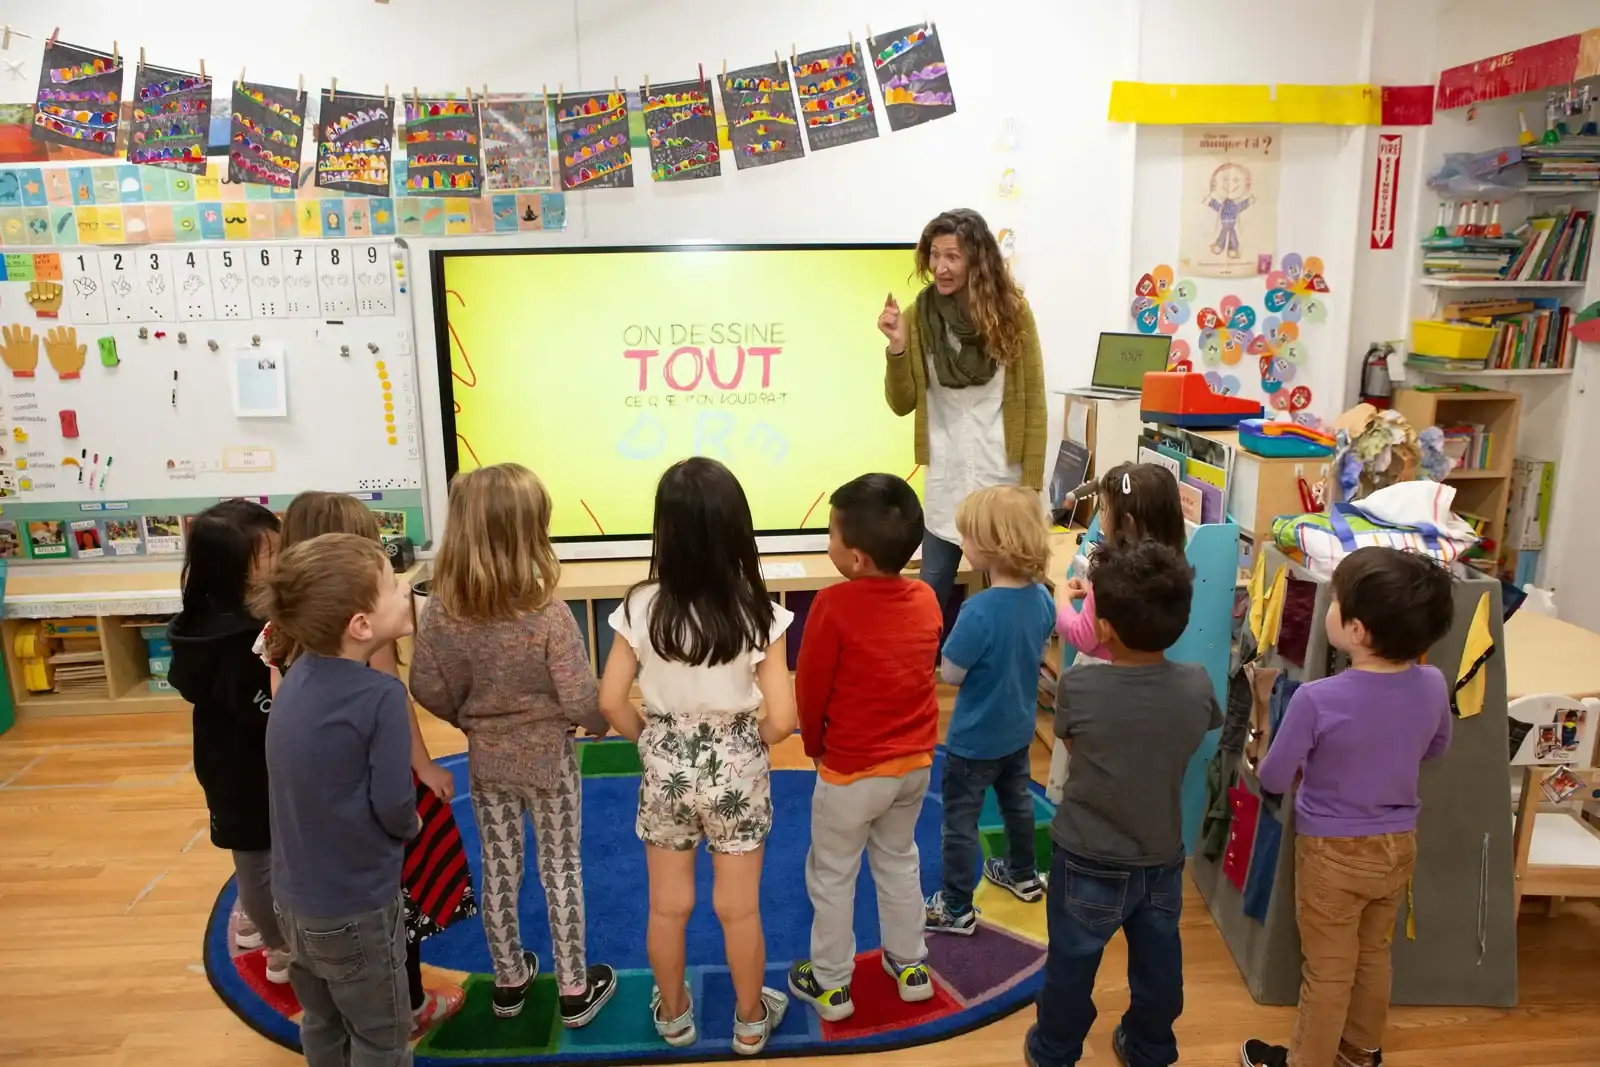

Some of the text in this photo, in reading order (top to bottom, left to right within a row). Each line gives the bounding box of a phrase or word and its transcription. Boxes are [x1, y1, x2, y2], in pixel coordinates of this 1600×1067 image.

[1380, 144, 1398, 155] FIRE
[77, 255, 85, 271] 1
[113, 253, 124, 270] 2
[150, 253, 159, 270] 3
[186, 252, 196, 268] 4
[223, 251, 232, 267] 5
[260, 249, 270, 266] 6
[293, 249, 303, 266] 7
[331, 248, 340, 265] 8
[367, 246, 377, 264] 9
[622, 322, 787, 347] ON DESSINE
[623, 345, 783, 391] TOUT
[624, 395, 643, 408] CE
